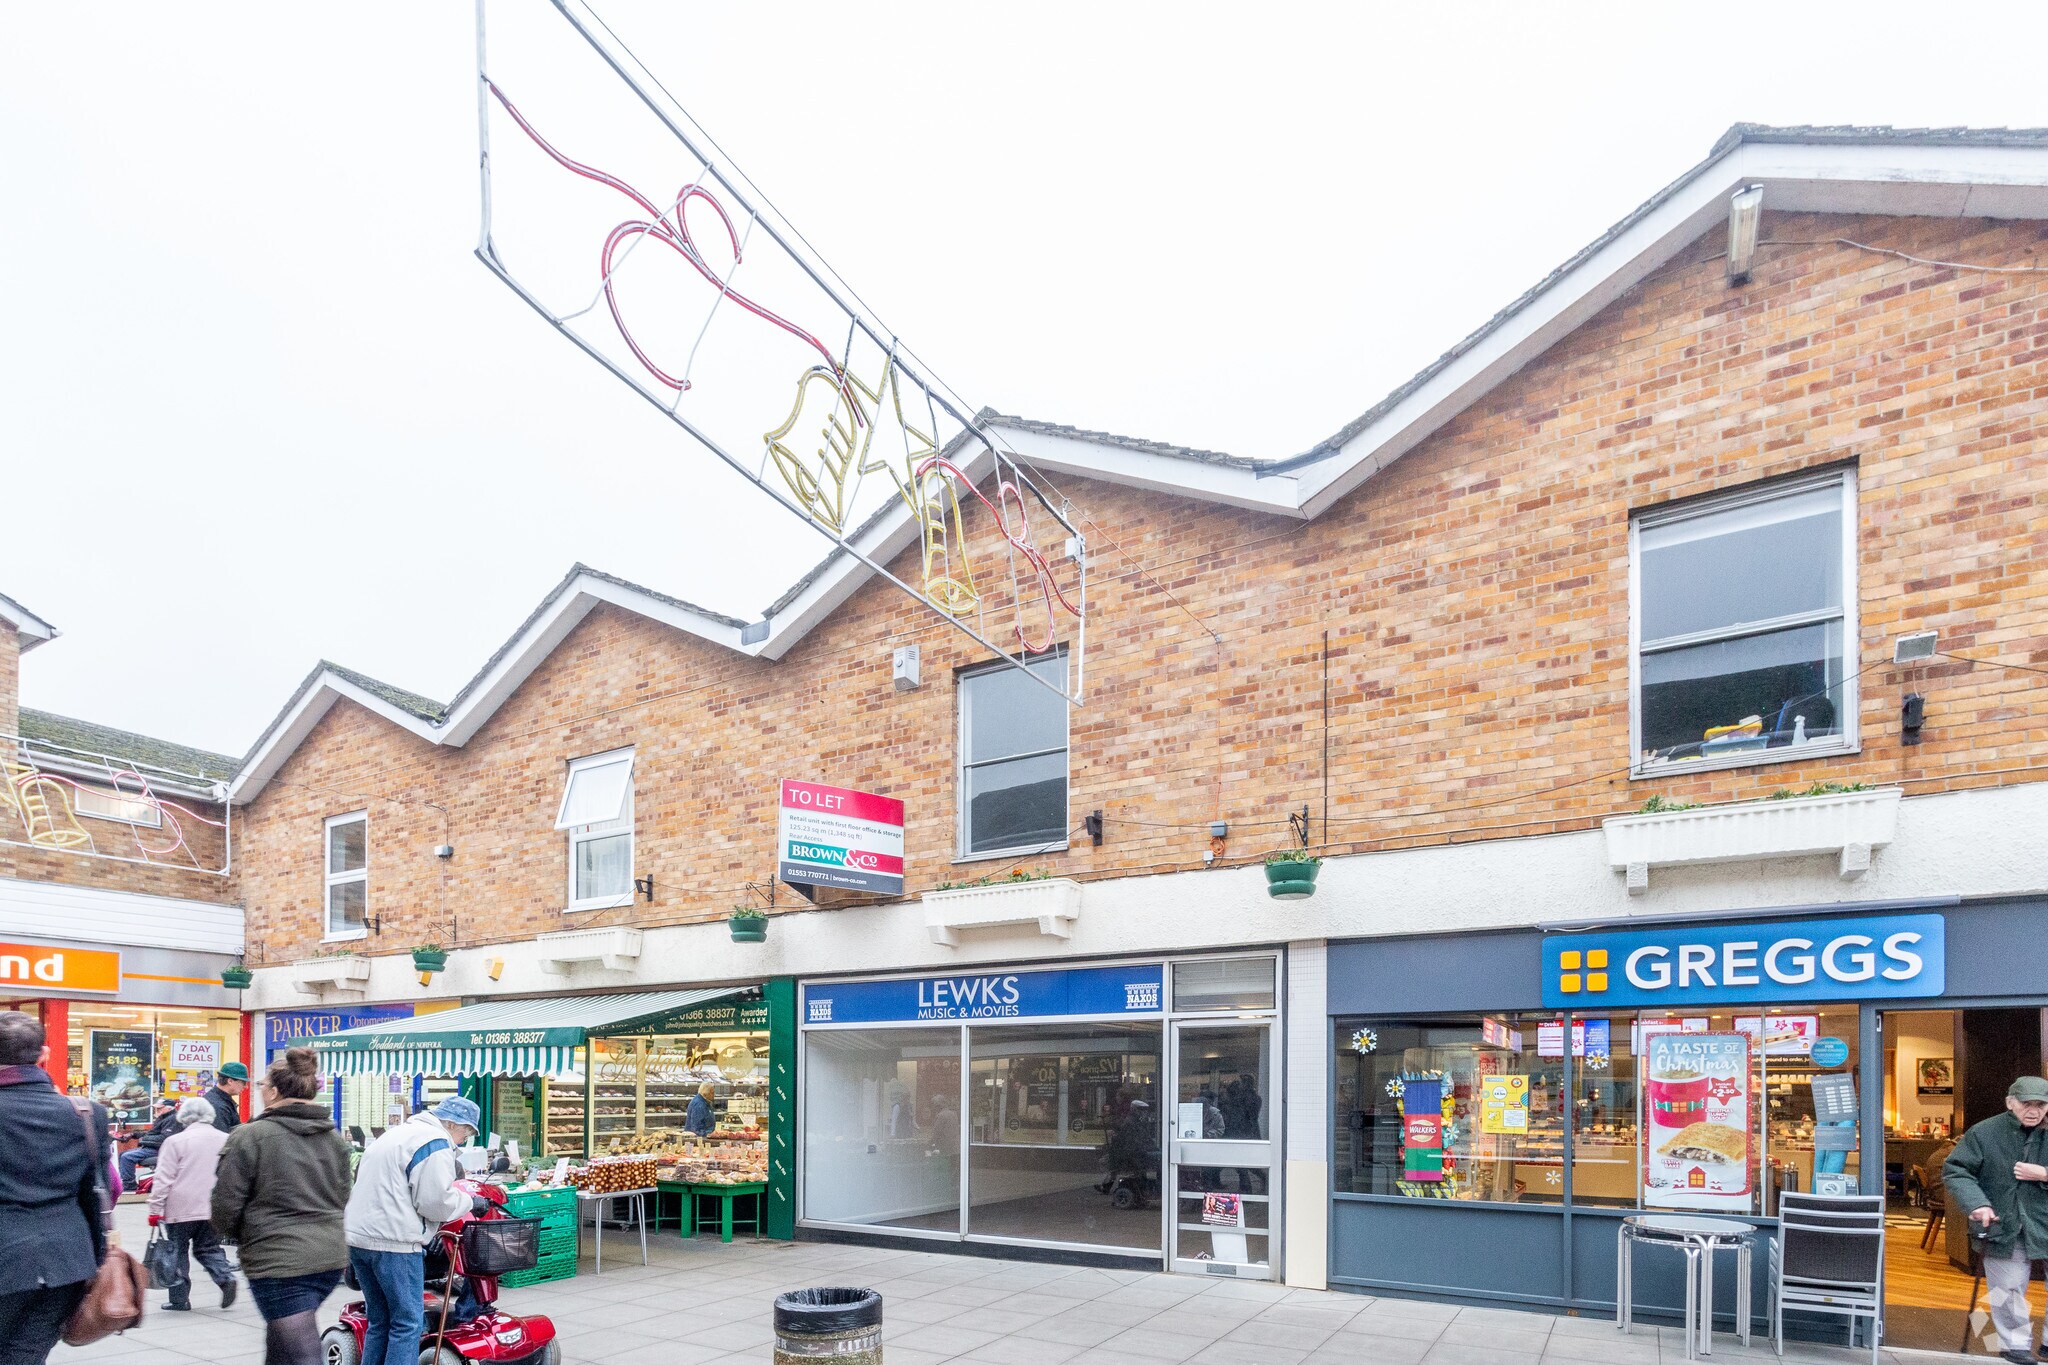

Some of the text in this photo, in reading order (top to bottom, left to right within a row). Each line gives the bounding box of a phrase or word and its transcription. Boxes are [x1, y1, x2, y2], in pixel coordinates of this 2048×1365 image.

[789, 788, 845, 809] TO LET
[789, 815, 808, 823] Retail
[835, 821, 847, 829] first
[847, 823, 862, 831] floor
[862, 826, 877, 835] office
[882, 831, 901, 840] storage
[789, 823, 811, 833] 125.23
[811, 826, 820, 835] sq
[847, 831, 855, 840] sq
[789, 832, 823, 843] Rear Access
[787, 868, 867, 885] 01553 770771 brown-co.com
[1625, 932, 1923, 990] GREGGS
[917, 976, 1020, 1008] LEWKS
[1127, 993, 1158, 1004] NAXOS
[705, 1007, 736, 1019] 388377
[740, 1007, 768, 1017] Awarded
[809, 1008, 832, 1016] NAXOS
[917, 1005, 1020, 1019] MUSIC & MOVIES
[272, 1015, 341, 1042] PARKER
[368, 1035, 443, 1051] Goddards OF NORFOLK
[470, 1031, 546, 1045] Tel: 01366 388377
[181, 1044, 211, 1053] 7 DAY
[1657, 1043, 1739, 1054] A TASTE OF
[106, 1055, 139, 1065] £1.89
[178, 1053, 213, 1062] DEALS
[600, 1045, 704, 1082] Goddards
[1656, 1053, 1740, 1073] Christmas
[1409, 1125, 1437, 1134] WALKERS
